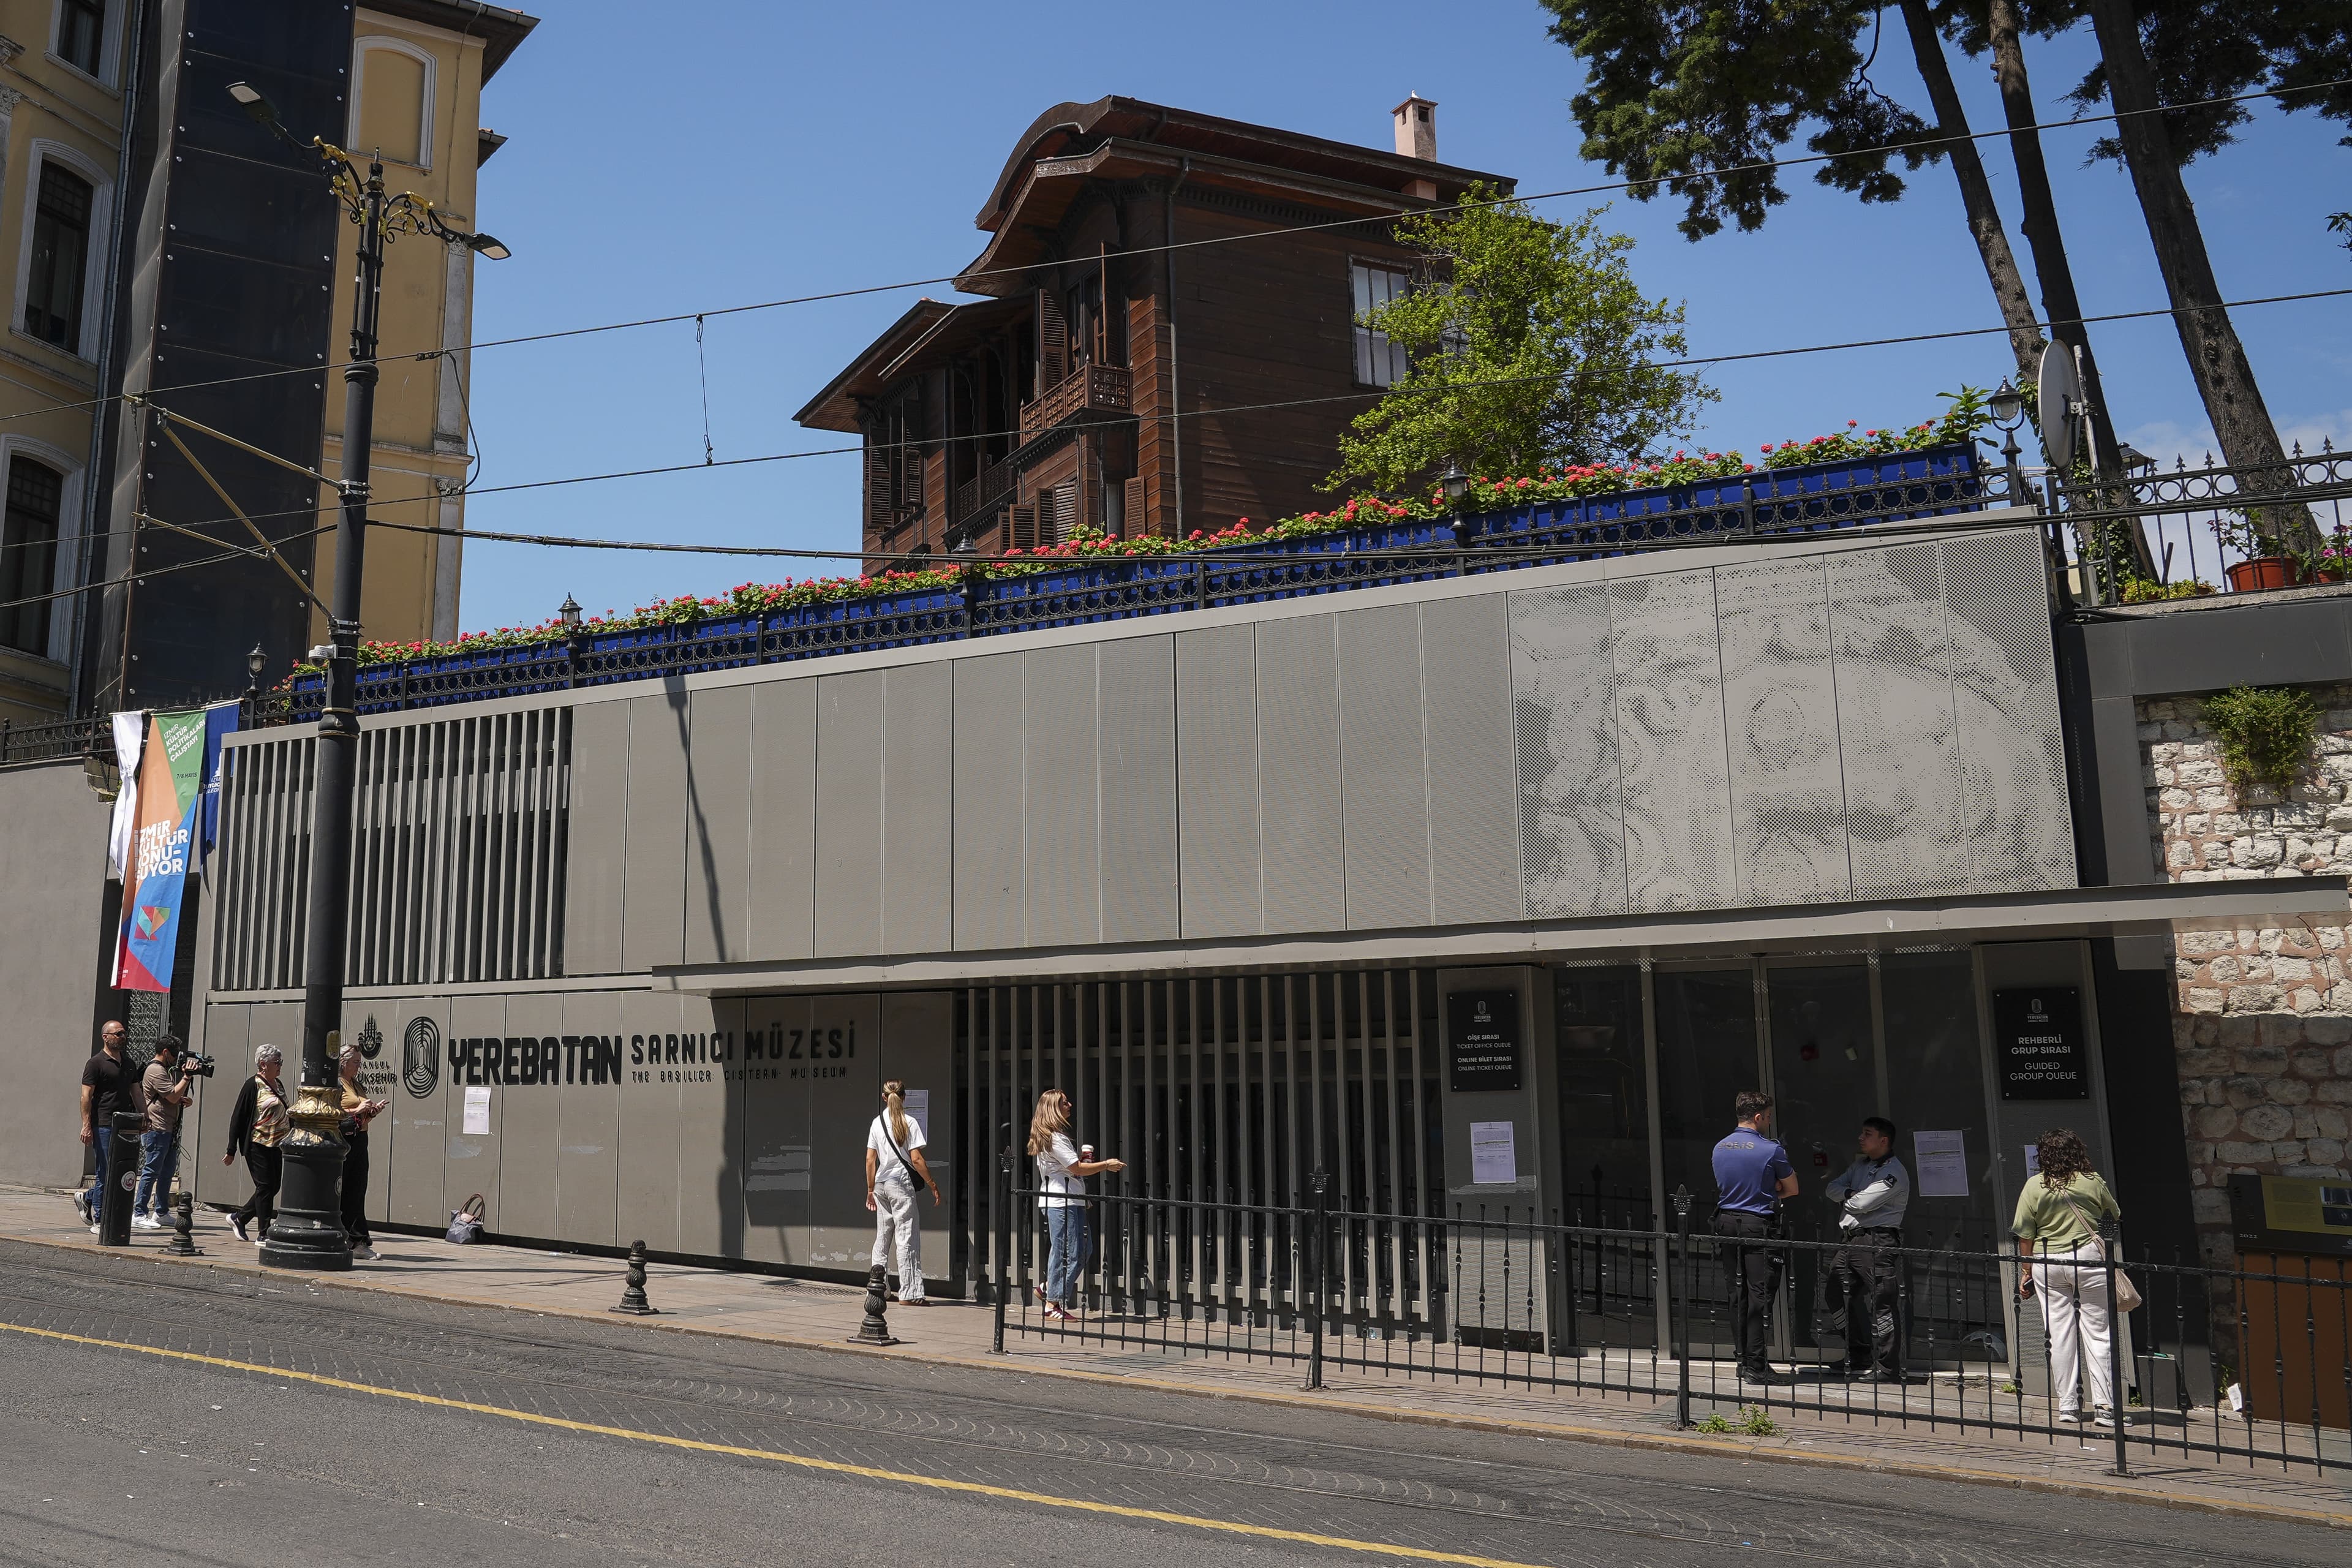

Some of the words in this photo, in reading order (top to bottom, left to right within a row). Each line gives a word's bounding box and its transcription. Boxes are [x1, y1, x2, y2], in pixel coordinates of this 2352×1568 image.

[165, 725, 187, 747] KÜLTÜR
[168, 719, 205, 755] POLİTİKALARI
[170, 735, 198, 762] ÇALIŞTAYI
[2018, 1034, 2062, 1044] REHBERLİ
[448, 1035, 622, 1085] YEREBATAN
[631, 1030, 733, 1065] SARNICI
[745, 1020, 855, 1060] MÜZESİ
[358, 1071, 398, 1087] ÜKŞEHİR
[631, 1070, 650, 1083] THE
[660, 1069, 713, 1083] BASILICA
[725, 1068, 777, 1081] CISTERN
[790, 1066, 847, 1080] MUSEUM
[2046, 1072, 2077, 1080] QUEUE
